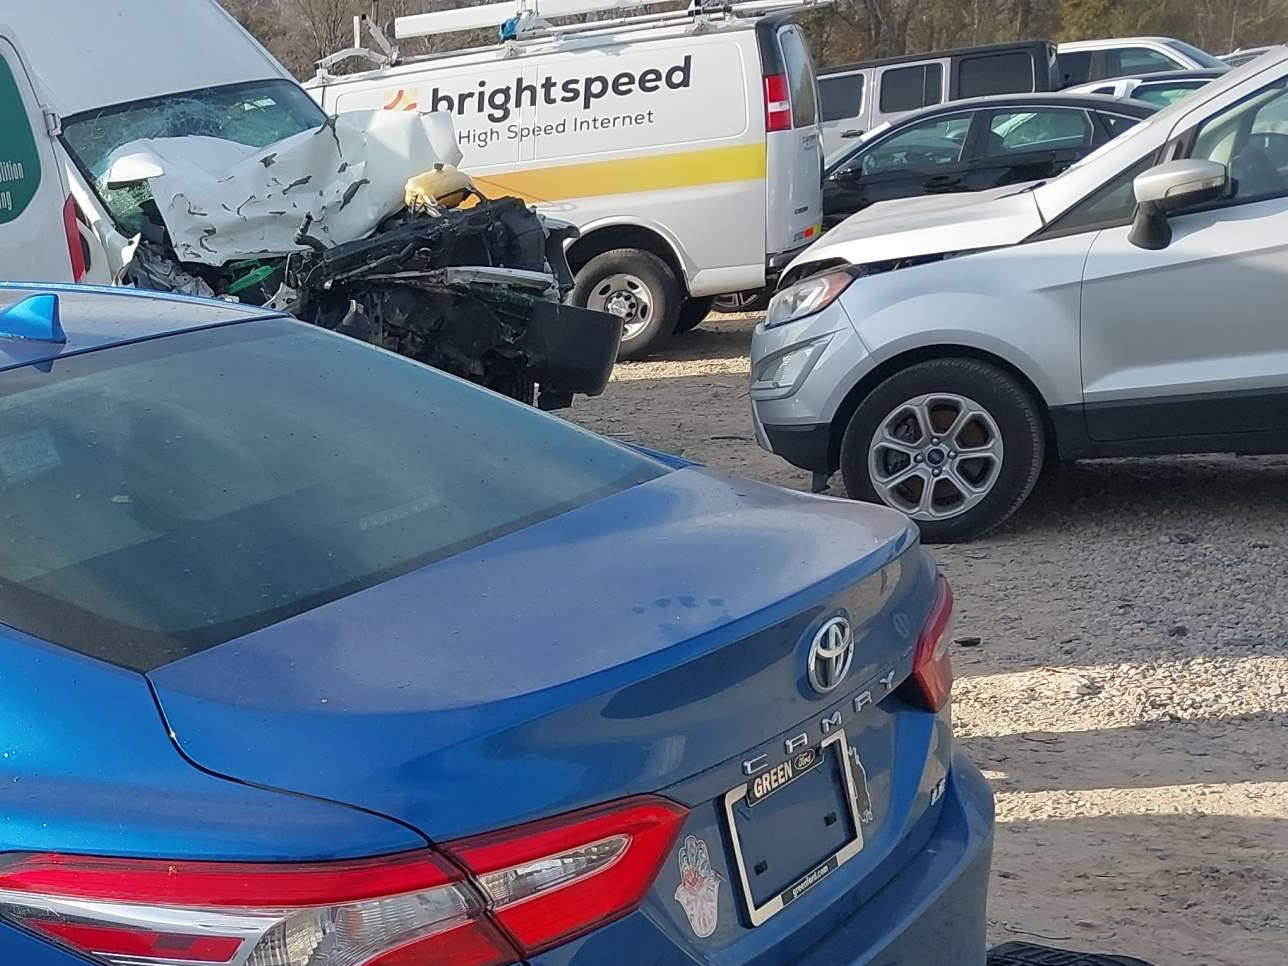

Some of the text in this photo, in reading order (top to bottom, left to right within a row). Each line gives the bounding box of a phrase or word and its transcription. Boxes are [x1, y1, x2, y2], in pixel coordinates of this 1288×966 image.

[431, 55, 692, 123] brightspeed
[458, 109, 655, 148] High Speed Internet
[743, 670, 895, 775] CAMRY
[753, 763, 794, 798] GREEN
